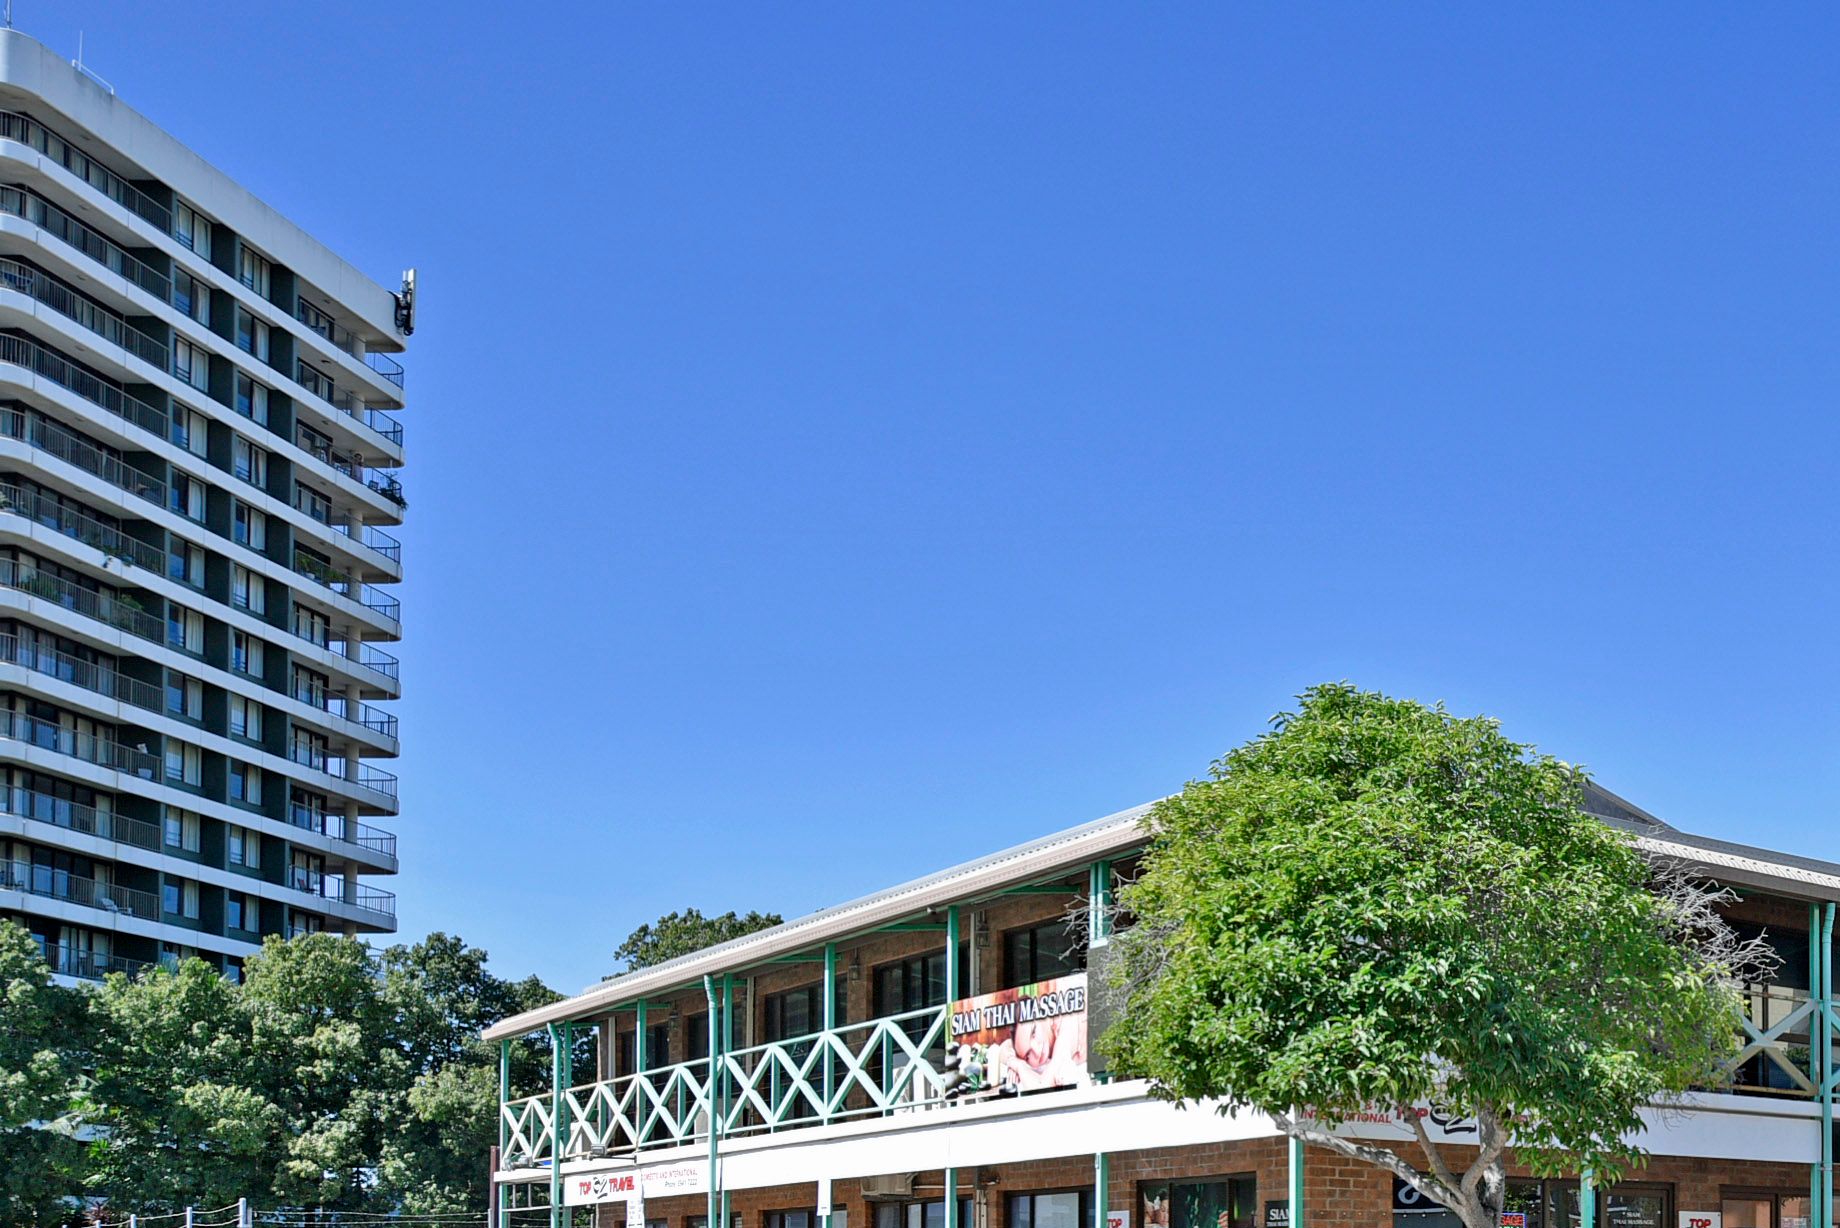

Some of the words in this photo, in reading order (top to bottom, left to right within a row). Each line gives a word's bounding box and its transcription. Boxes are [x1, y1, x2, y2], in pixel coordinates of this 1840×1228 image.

[951, 1008, 981, 1036] SIAM
[983, 1001, 1016, 1029] THAI
[1019, 986, 1085, 1023] MASSAGE
[579, 1181, 592, 1195] TOP
[609, 1176, 634, 1193] TRAVEL
[1689, 1219, 1712, 1228] TOP
